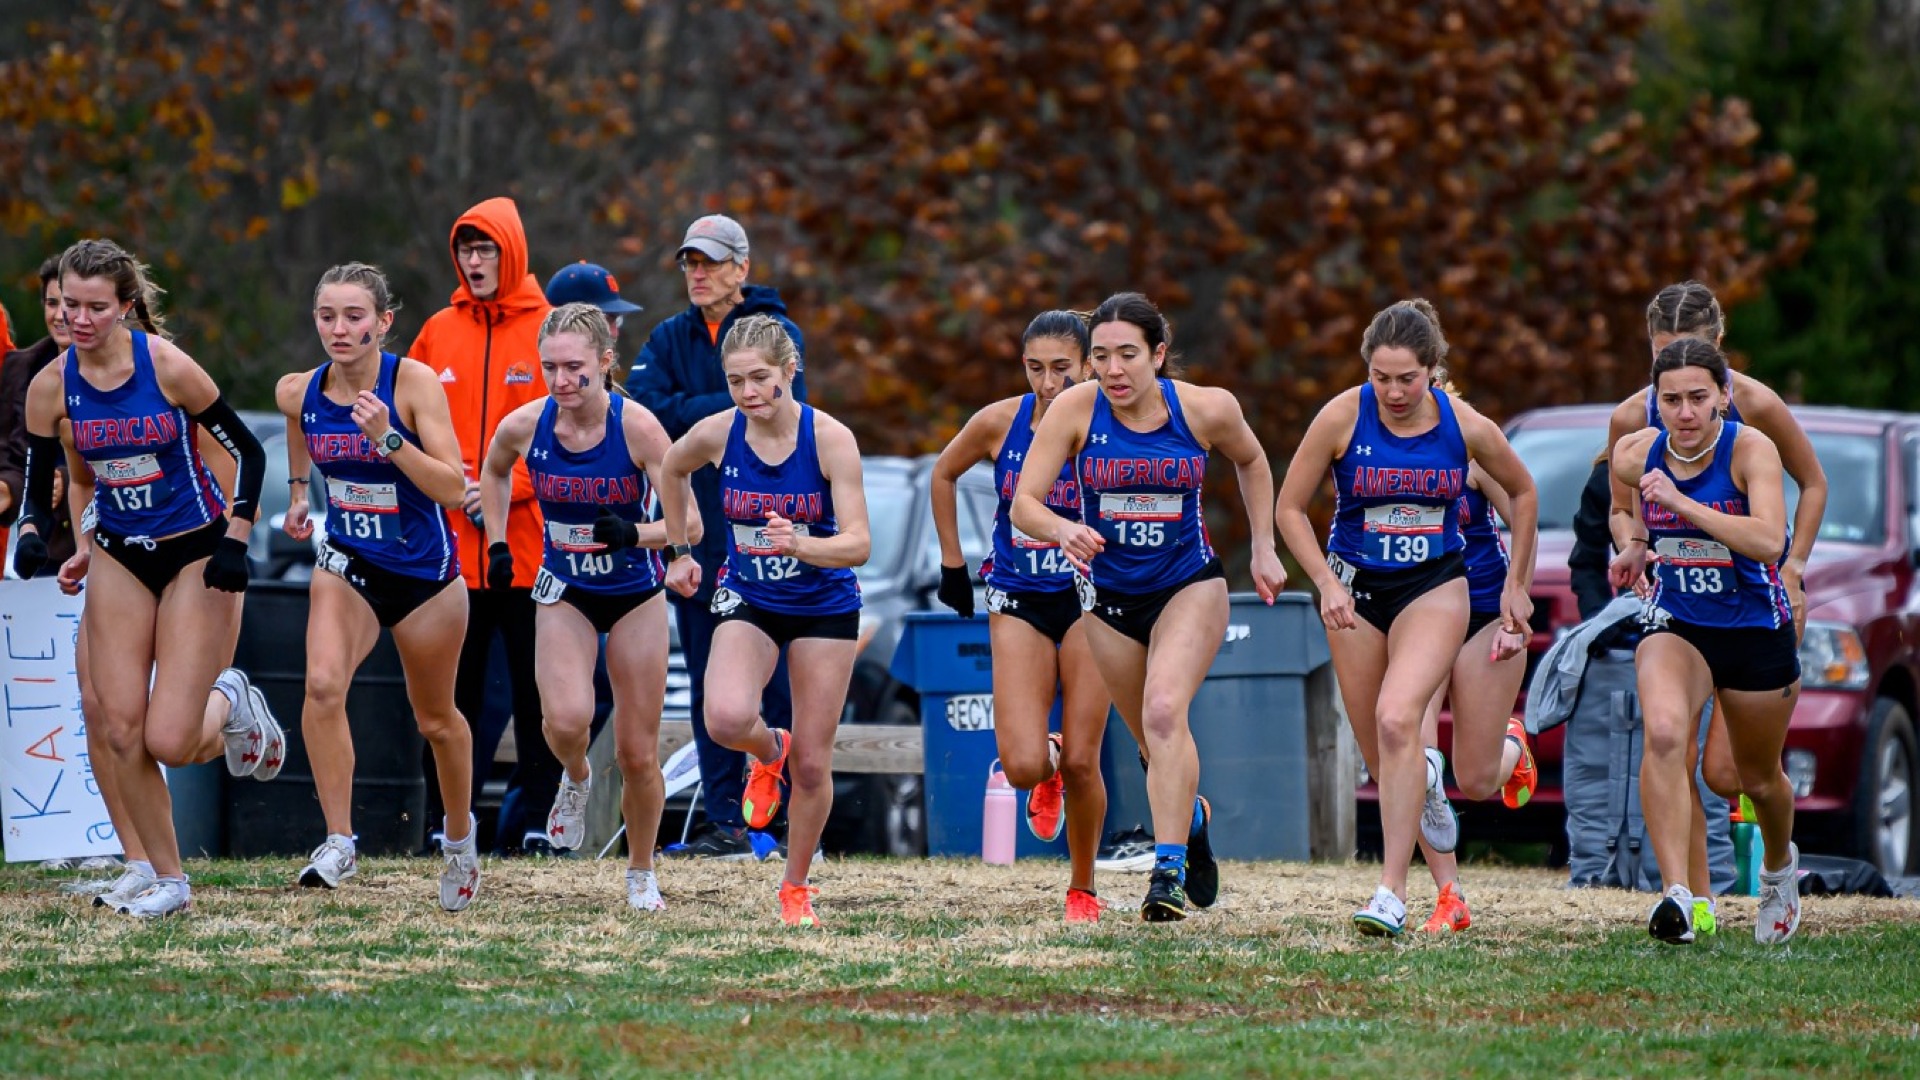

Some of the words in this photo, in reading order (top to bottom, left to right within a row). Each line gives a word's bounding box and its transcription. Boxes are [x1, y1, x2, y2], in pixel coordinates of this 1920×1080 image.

[72, 411, 179, 449] MERICAN
[306, 433, 391, 463] MERICA
[1084, 456, 1206, 489] AMERICAN
[1352, 466, 1463, 500] AMERICAN
[111, 484, 153, 511] 137
[723, 488, 823, 522] AMERICAN
[341, 511, 382, 539] 131
[1114, 520, 1165, 547] 135
[1025, 548, 1075, 574] 142
[1379, 534, 1430, 562] 139
[565, 552, 614, 576] 140
[751, 555, 801, 580] 132
[1675, 567, 1724, 593] 133
